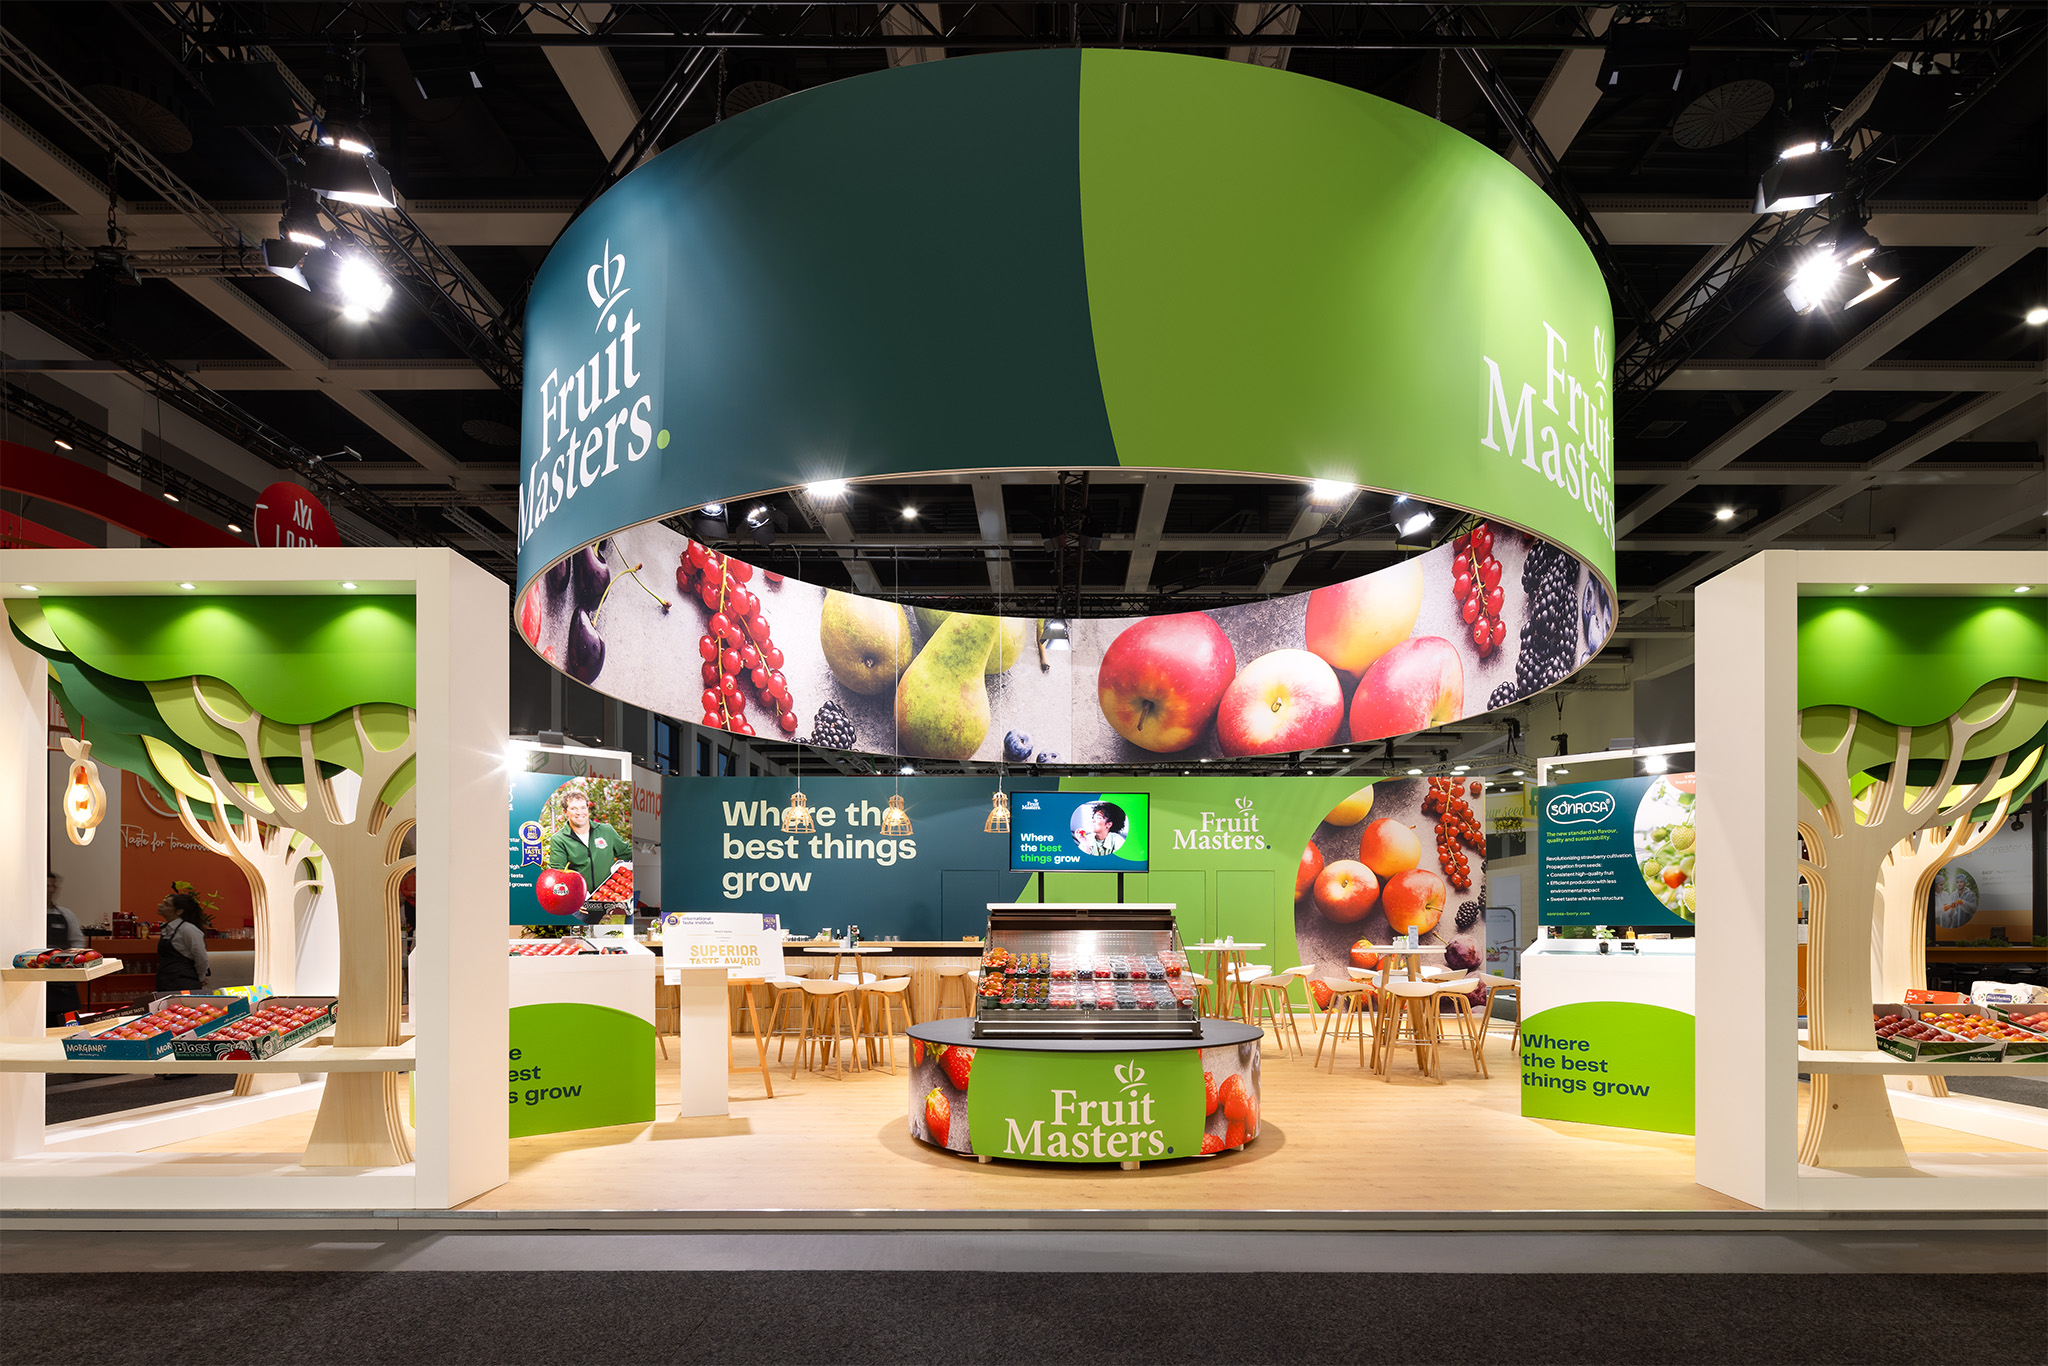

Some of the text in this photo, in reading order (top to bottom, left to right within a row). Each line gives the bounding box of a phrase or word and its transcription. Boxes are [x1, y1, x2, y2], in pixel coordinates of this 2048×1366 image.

[540, 308, 641, 462] Fruit
[1543, 320, 1611, 482] Fruit
[633, 780, 662, 821] kamp
[722, 800, 902, 827] Where the
[1200, 811, 1259, 832] Fruit
[120, 824, 149, 848] Taste
[151, 831, 166, 852] for
[1020, 833, 1054, 842] Where
[1020, 843, 1062, 852] the best
[723, 833, 917, 867] best things
[1020, 853, 1080, 864] things grow
[722, 871, 812, 899] grow
[690, 945, 758, 957] SUPERIOR
[724, 957, 761, 966] AWARD
[1522, 1033, 1590, 1052] Where
[1889, 1046, 1912, 1059] organics
[1522, 1052, 1608, 1073] the best
[509, 1065, 541, 1082] est
[1522, 1071, 1650, 1097] things grow
[525, 1085, 582, 1106] grow
[1050, 1089, 1156, 1126] Fruit
